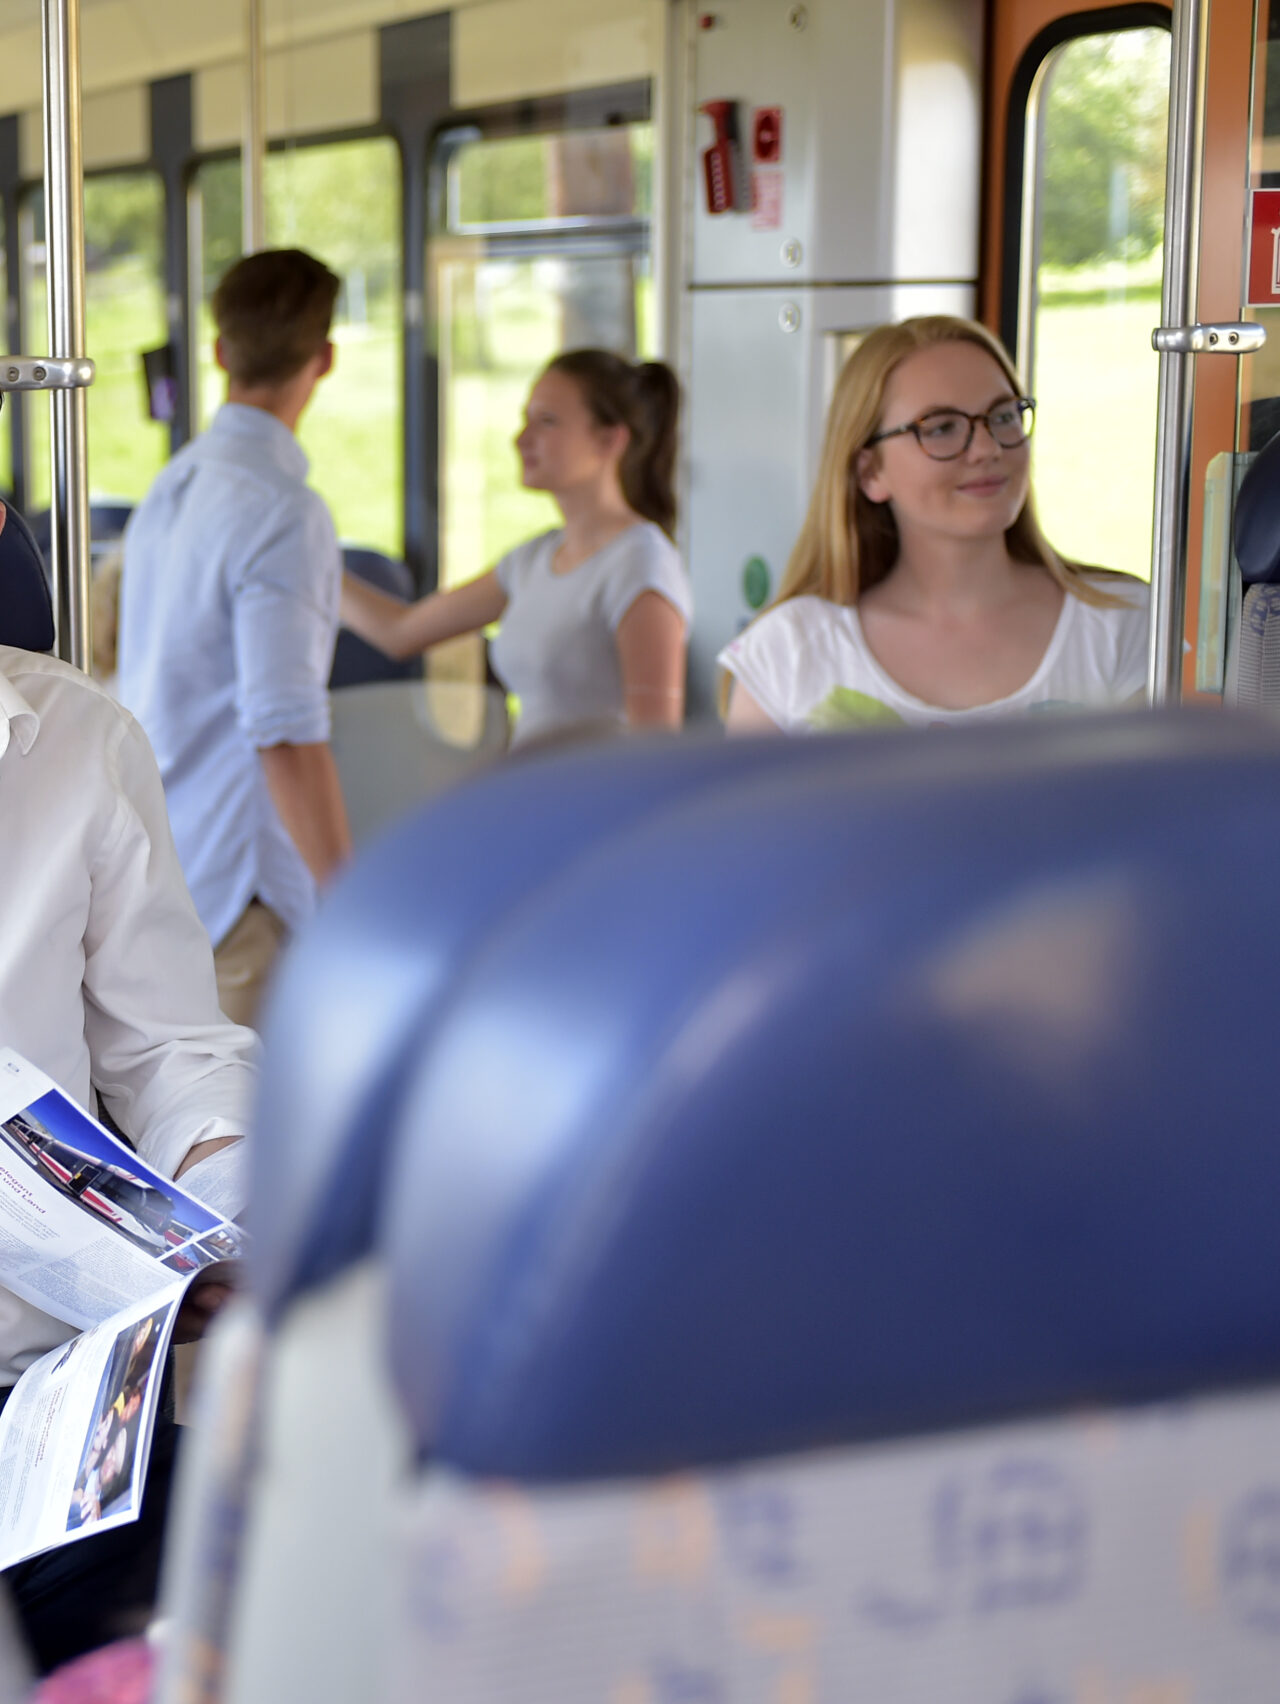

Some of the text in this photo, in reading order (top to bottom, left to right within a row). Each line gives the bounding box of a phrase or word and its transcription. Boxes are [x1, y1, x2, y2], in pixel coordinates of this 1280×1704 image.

[0, 1166, 33, 1197] elegant
[3, 1177, 21, 1194] und
[21, 1194, 47, 1214] Land
